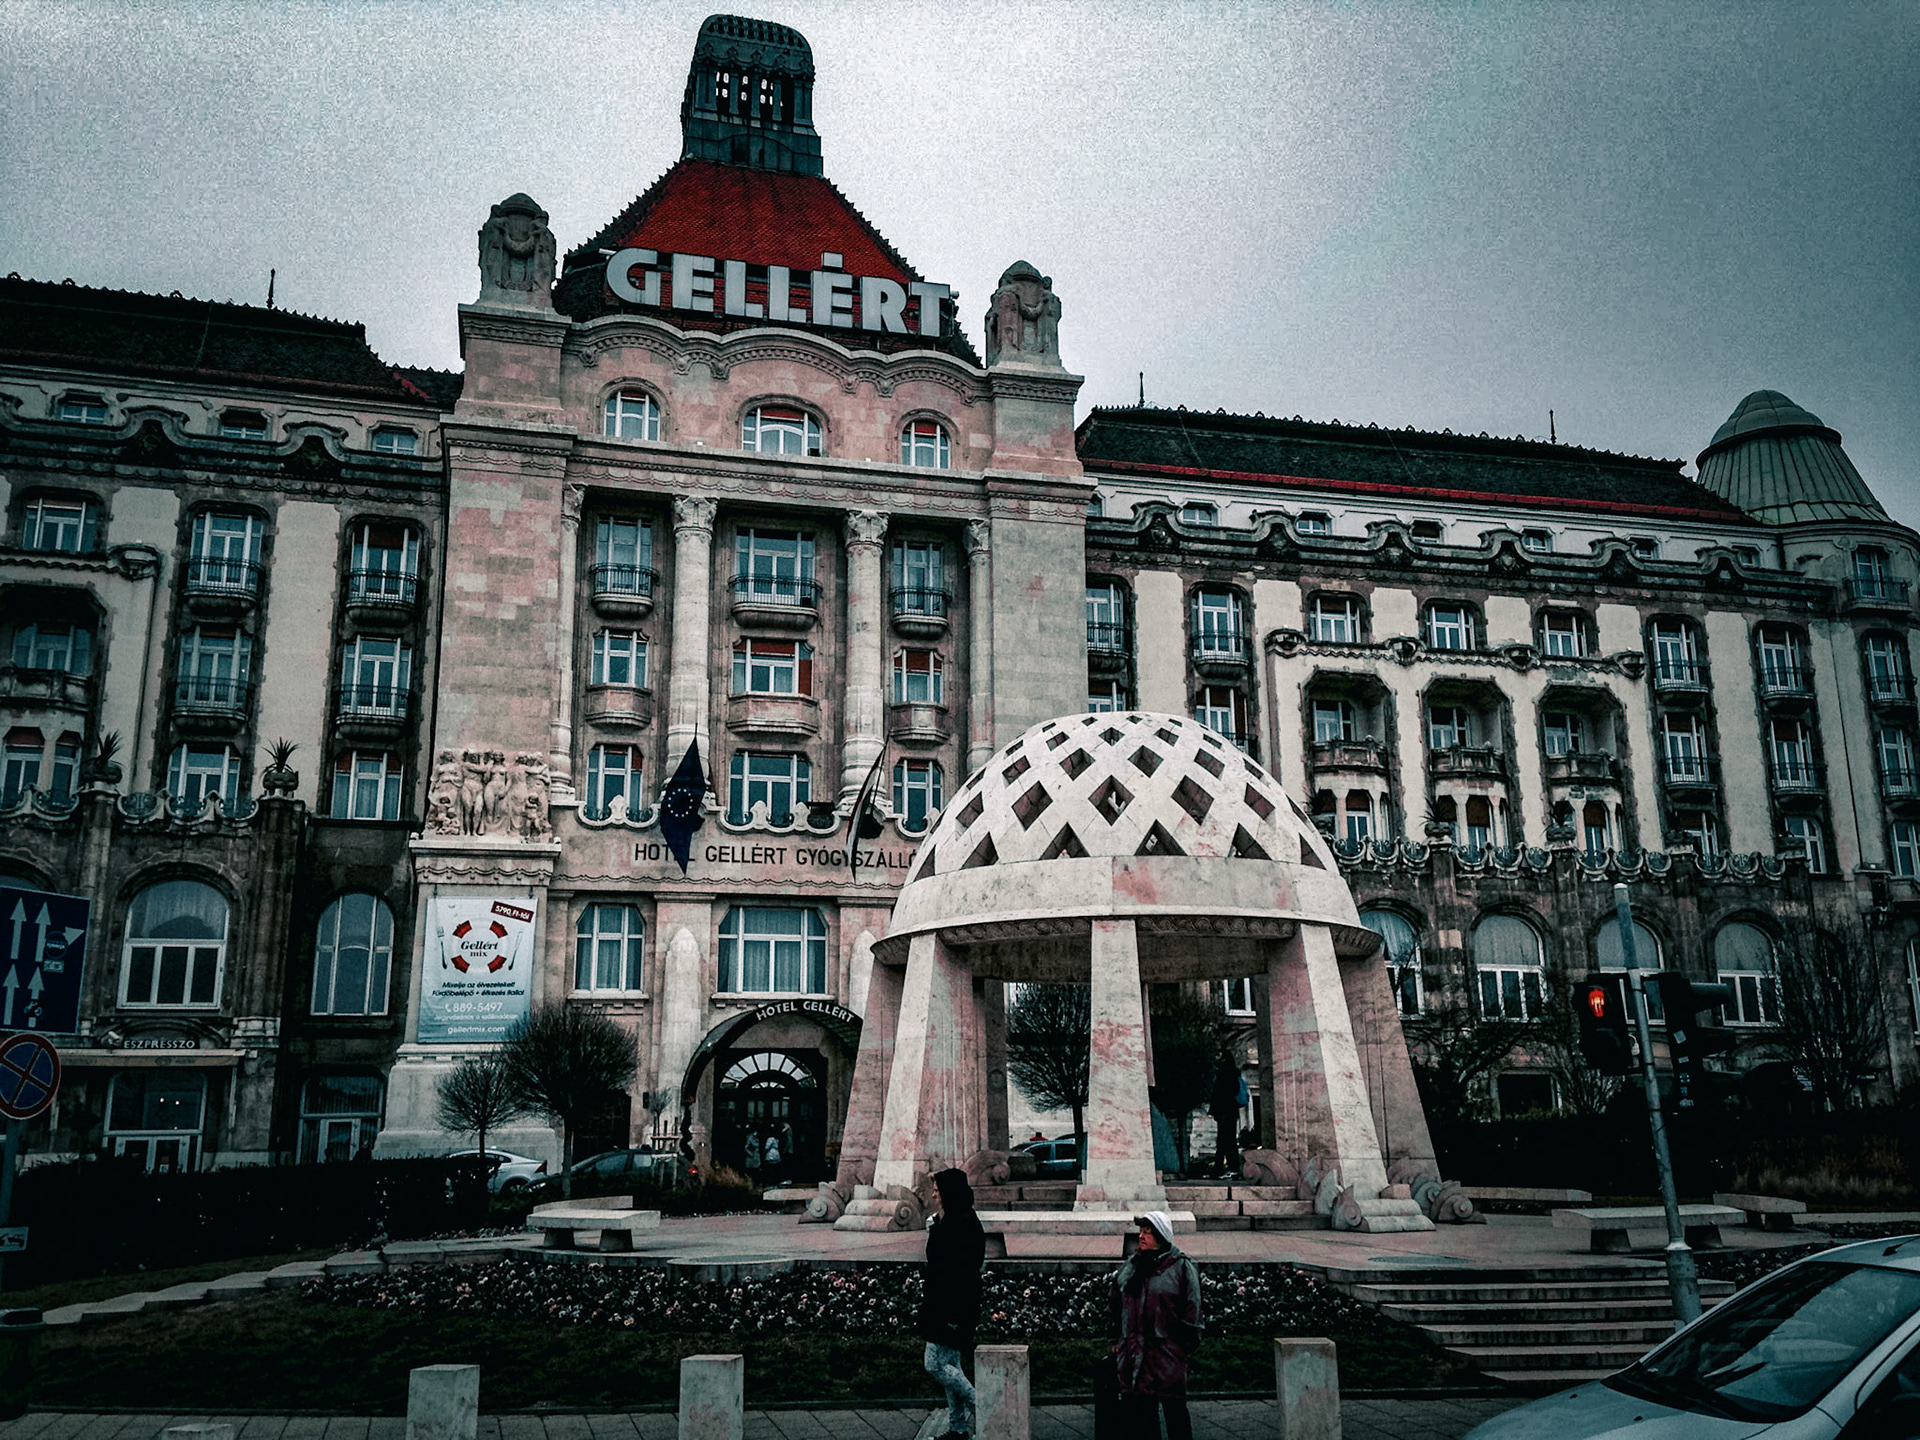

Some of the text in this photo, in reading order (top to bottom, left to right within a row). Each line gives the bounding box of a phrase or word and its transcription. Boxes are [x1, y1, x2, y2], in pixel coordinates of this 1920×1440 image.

[606, 247, 951, 338] GELLÉRT
[635, 843, 696, 862] HOT
[705, 842, 787, 866] GELLÉRT
[460, 941, 499, 950] Gellért
[453, 1002, 503, 1012] 889-5497
[756, 1001, 798, 1021] HOTEL
[447, 1026, 506, 1034] gellertmix.com
[124, 1040, 196, 1049] ESZPRESSZO
